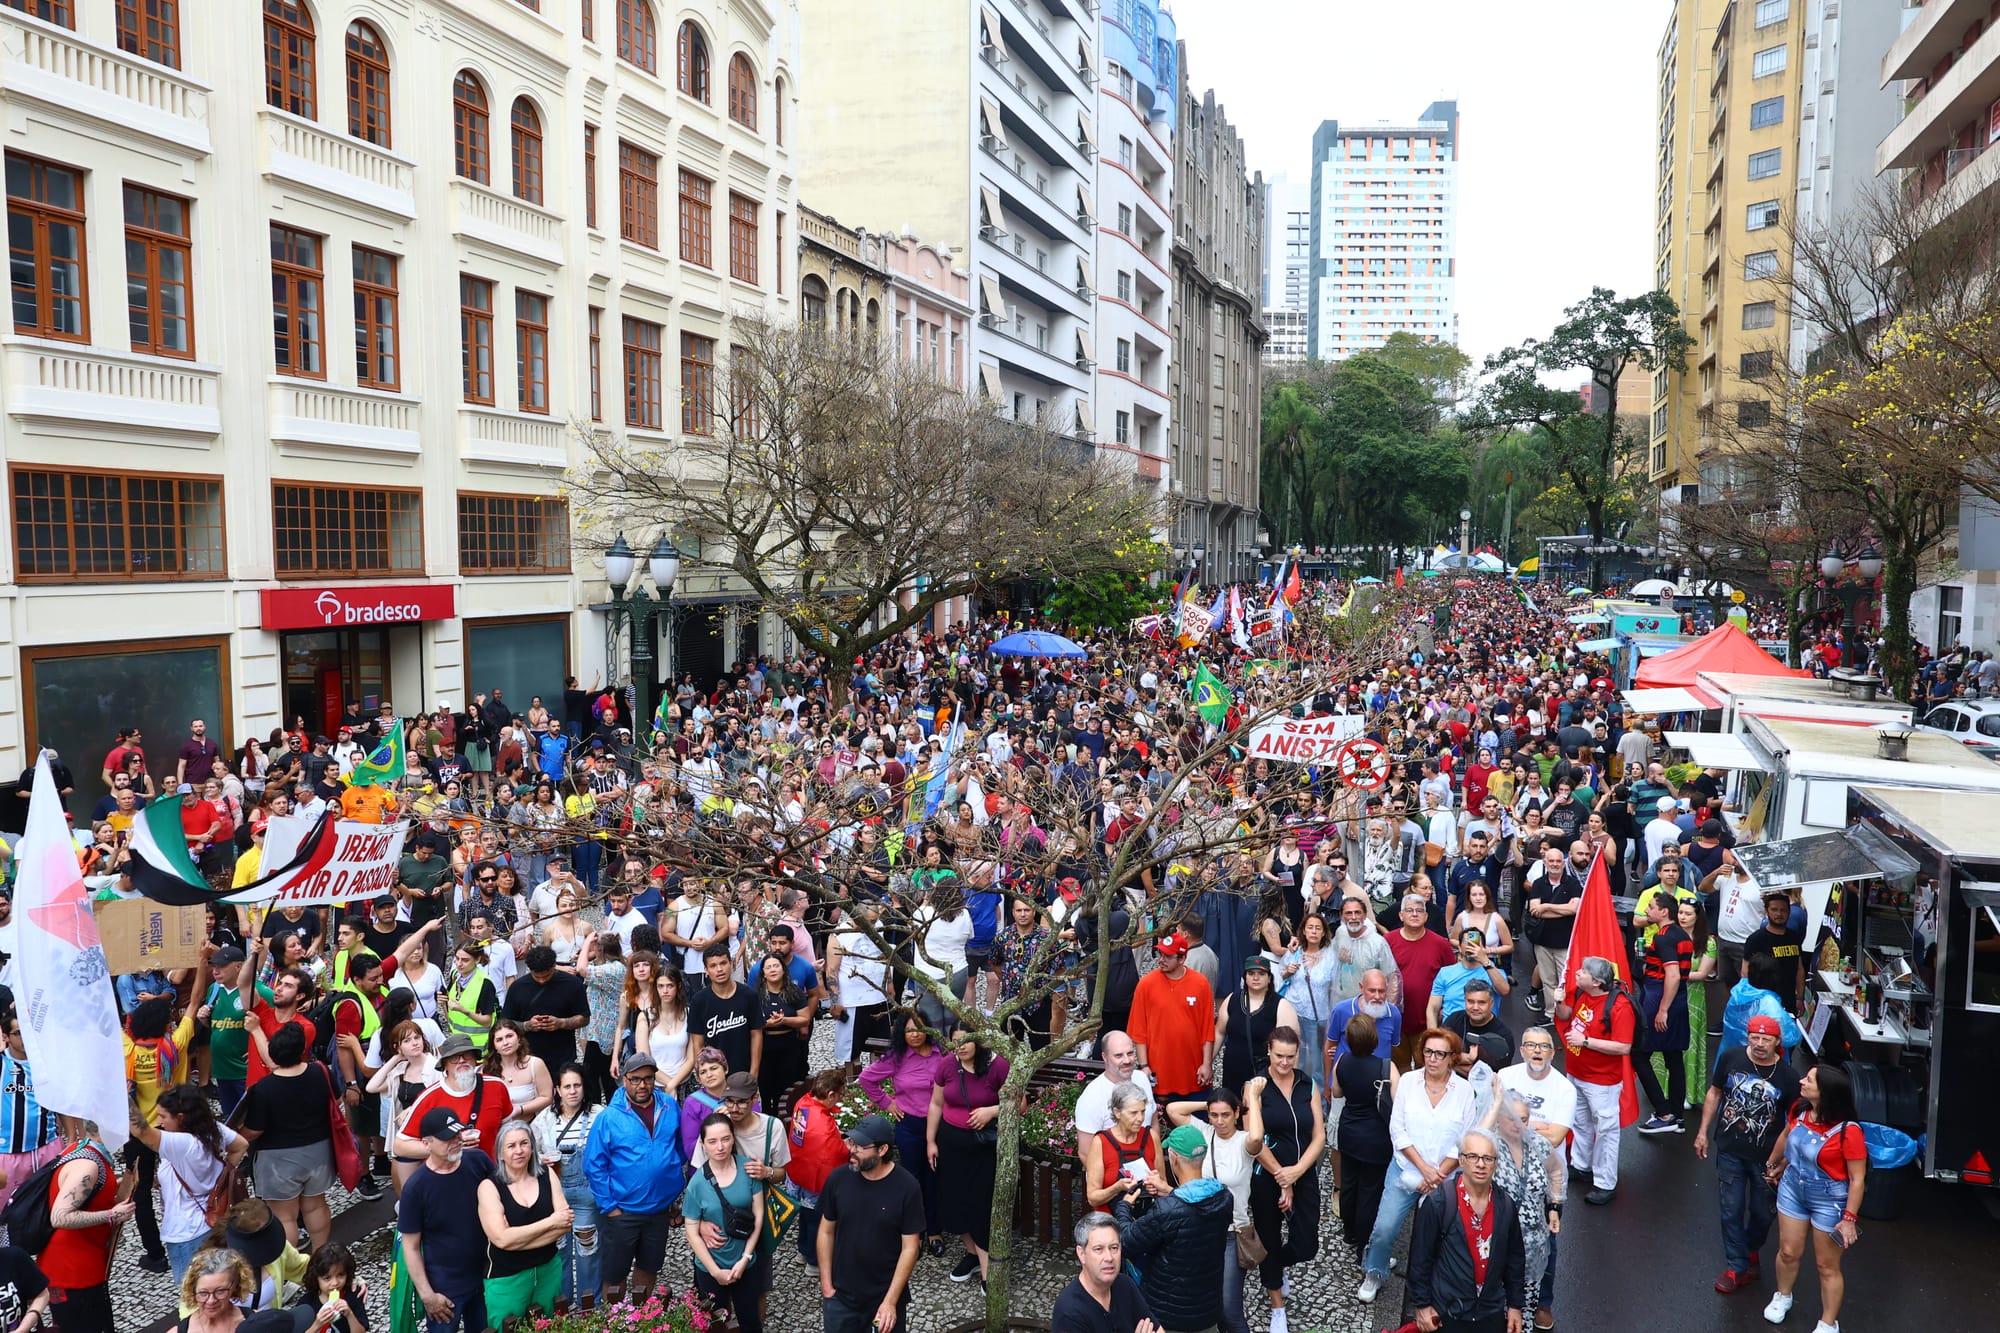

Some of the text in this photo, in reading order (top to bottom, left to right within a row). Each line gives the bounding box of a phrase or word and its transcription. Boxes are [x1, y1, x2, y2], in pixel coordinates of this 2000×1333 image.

[345, 600, 421, 623] bradesco
[1183, 605, 1208, 626] FOGO
[1283, 721, 1335, 736] SEM
[336, 833, 394, 863] IREMOS
[331, 869, 349, 897] O
[345, 861, 394, 897] PASSADO
[706, 1011, 748, 1038] Jordan
